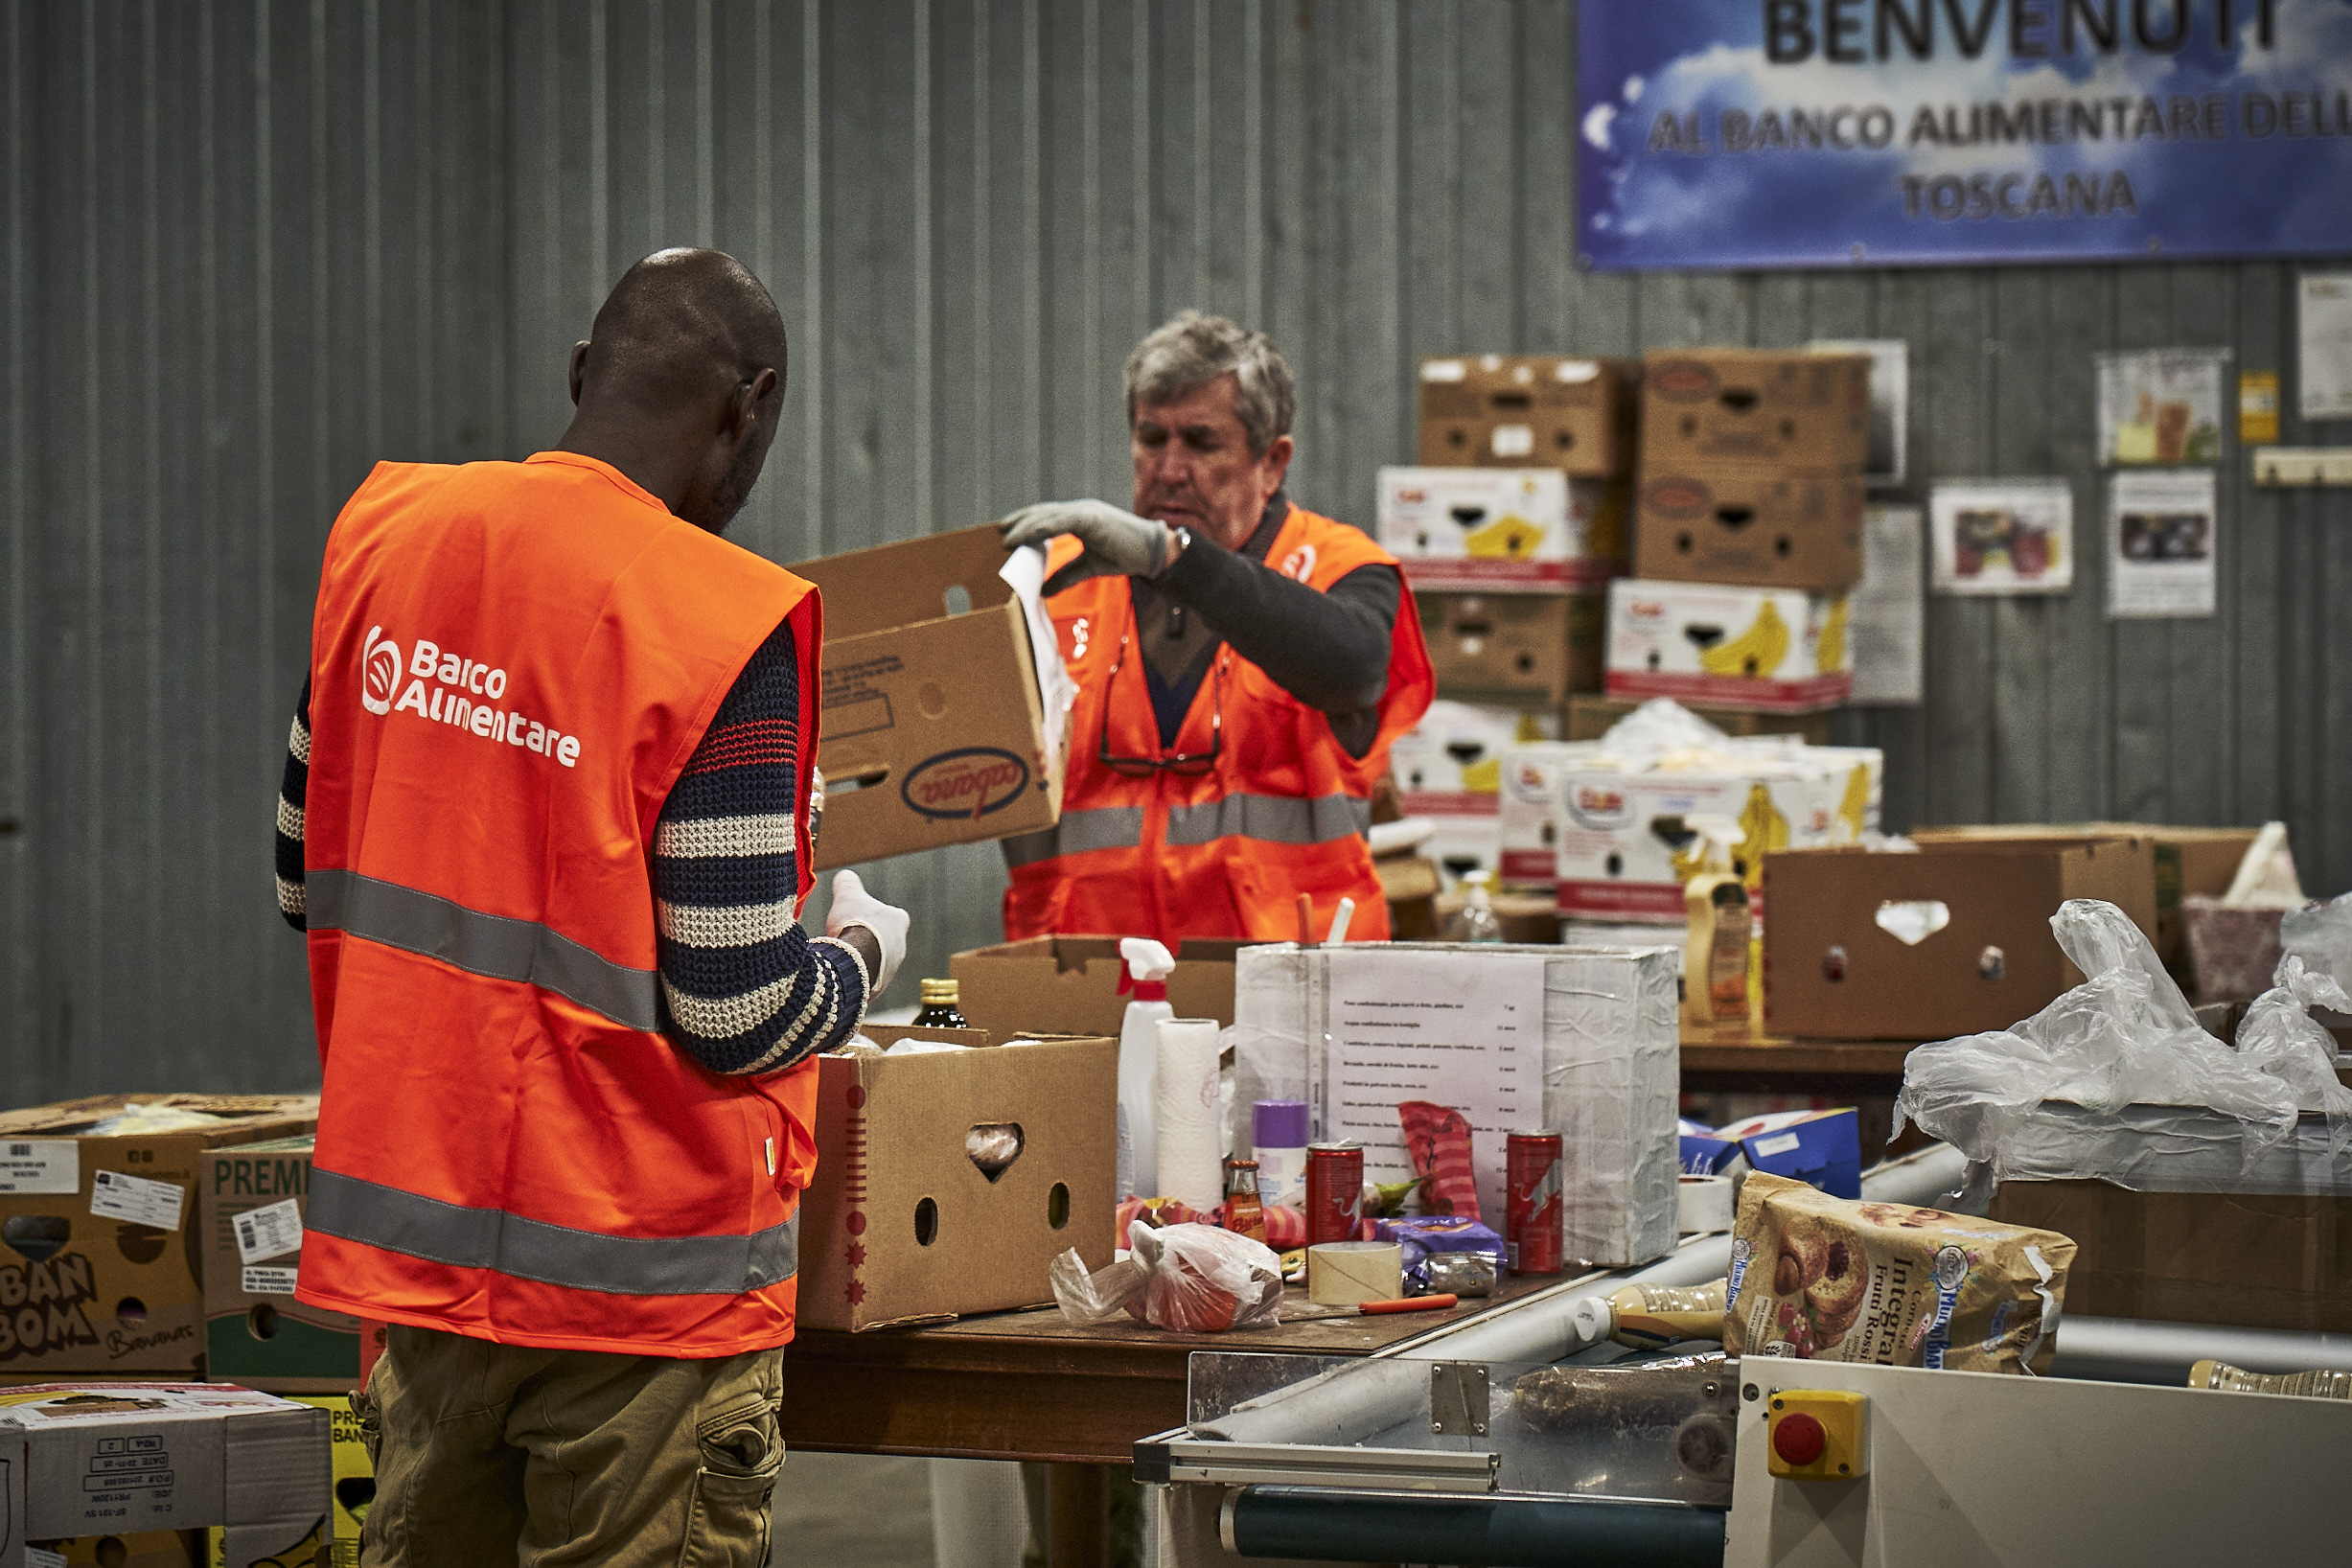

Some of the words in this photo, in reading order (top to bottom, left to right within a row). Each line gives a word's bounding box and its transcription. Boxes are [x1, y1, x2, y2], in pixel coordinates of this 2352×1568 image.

[1763, 0, 2275, 65] BENVENUTI
[1648, 109, 1708, 154] AL
[1722, 104, 1895, 151] BANCO
[1907, 93, 2230, 148] ALIMENTARE
[1899, 170, 2138, 220] TOSCANA
[0, 1253, 98, 1306] BAN
[1870, 1264, 1888, 1311] Frutti
[1860, 1315, 1879, 1360] Rossi
[142, 1457, 166, 1465] DATE
